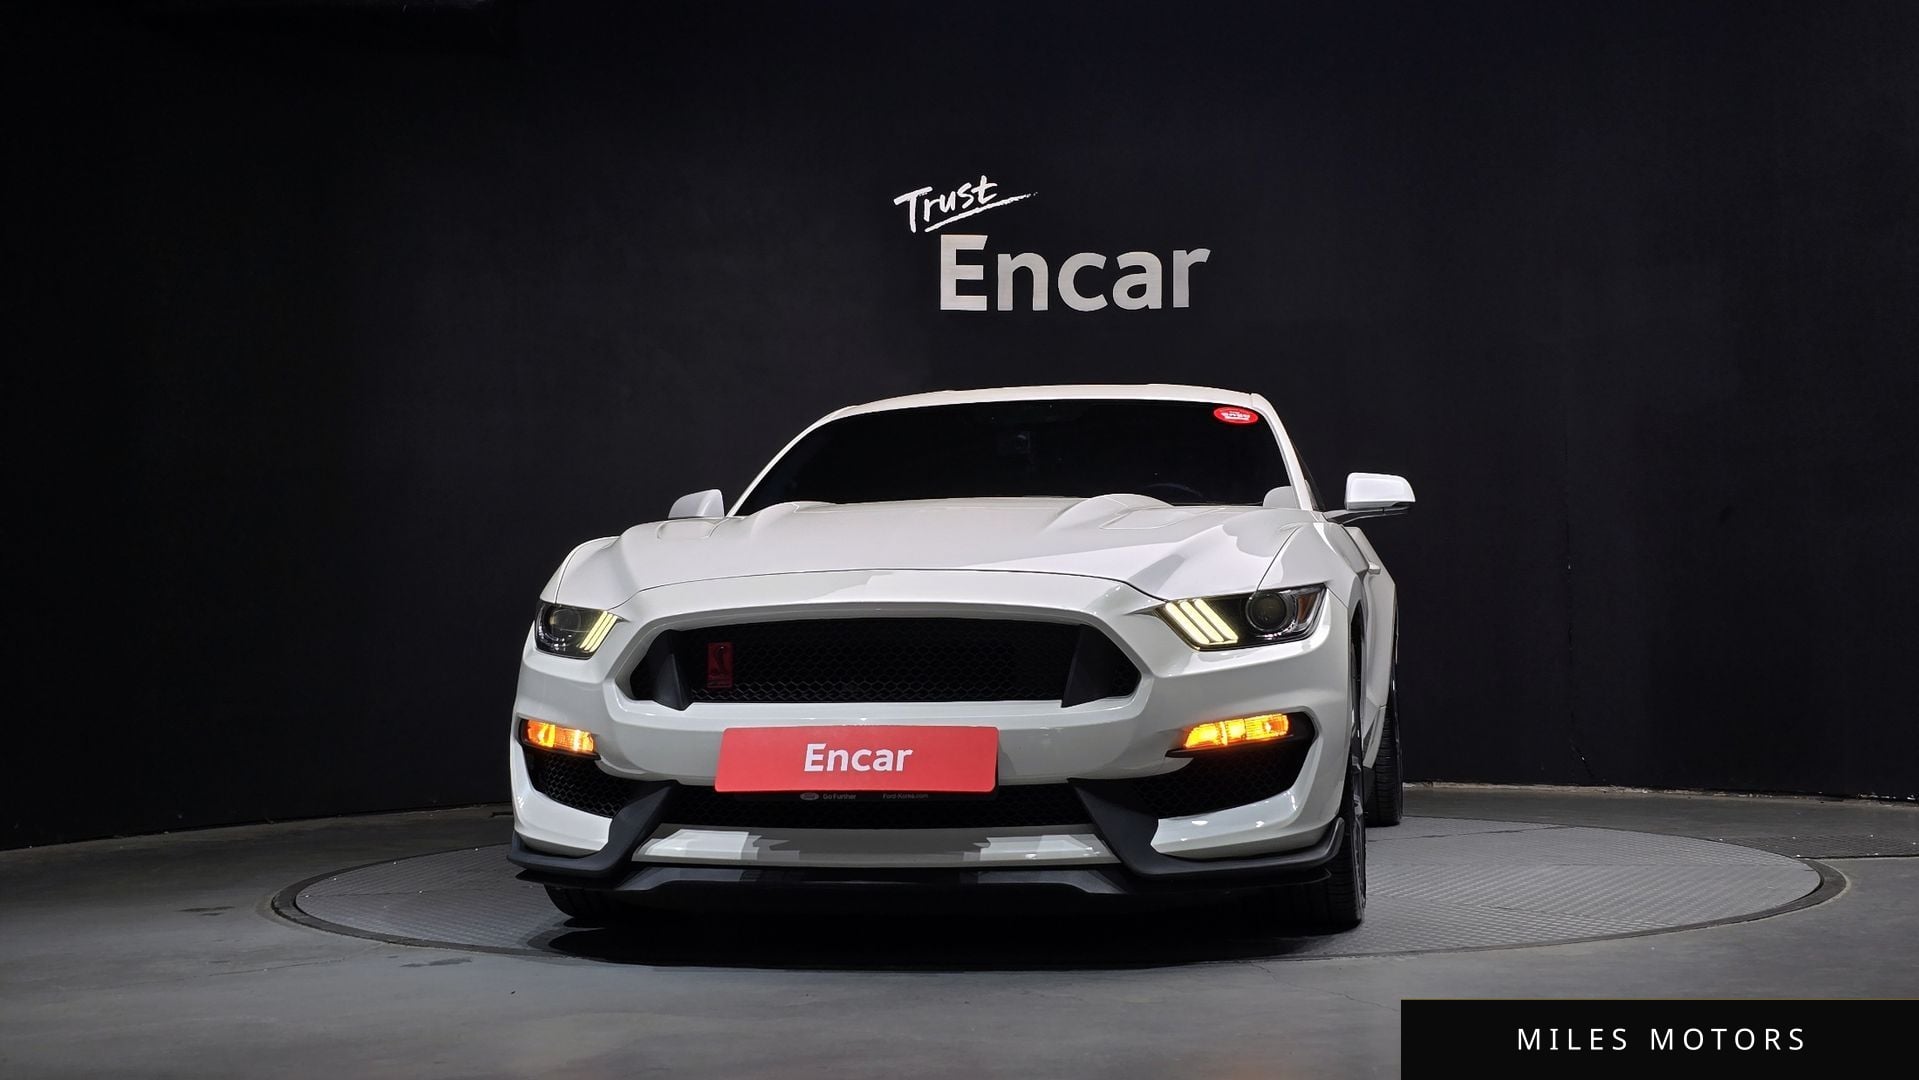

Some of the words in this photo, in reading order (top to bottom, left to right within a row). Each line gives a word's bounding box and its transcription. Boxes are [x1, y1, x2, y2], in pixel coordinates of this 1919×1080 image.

[894, 175, 998, 233] Trust
[940, 234, 1211, 312] Encar
[804, 743, 913, 772] Encar
